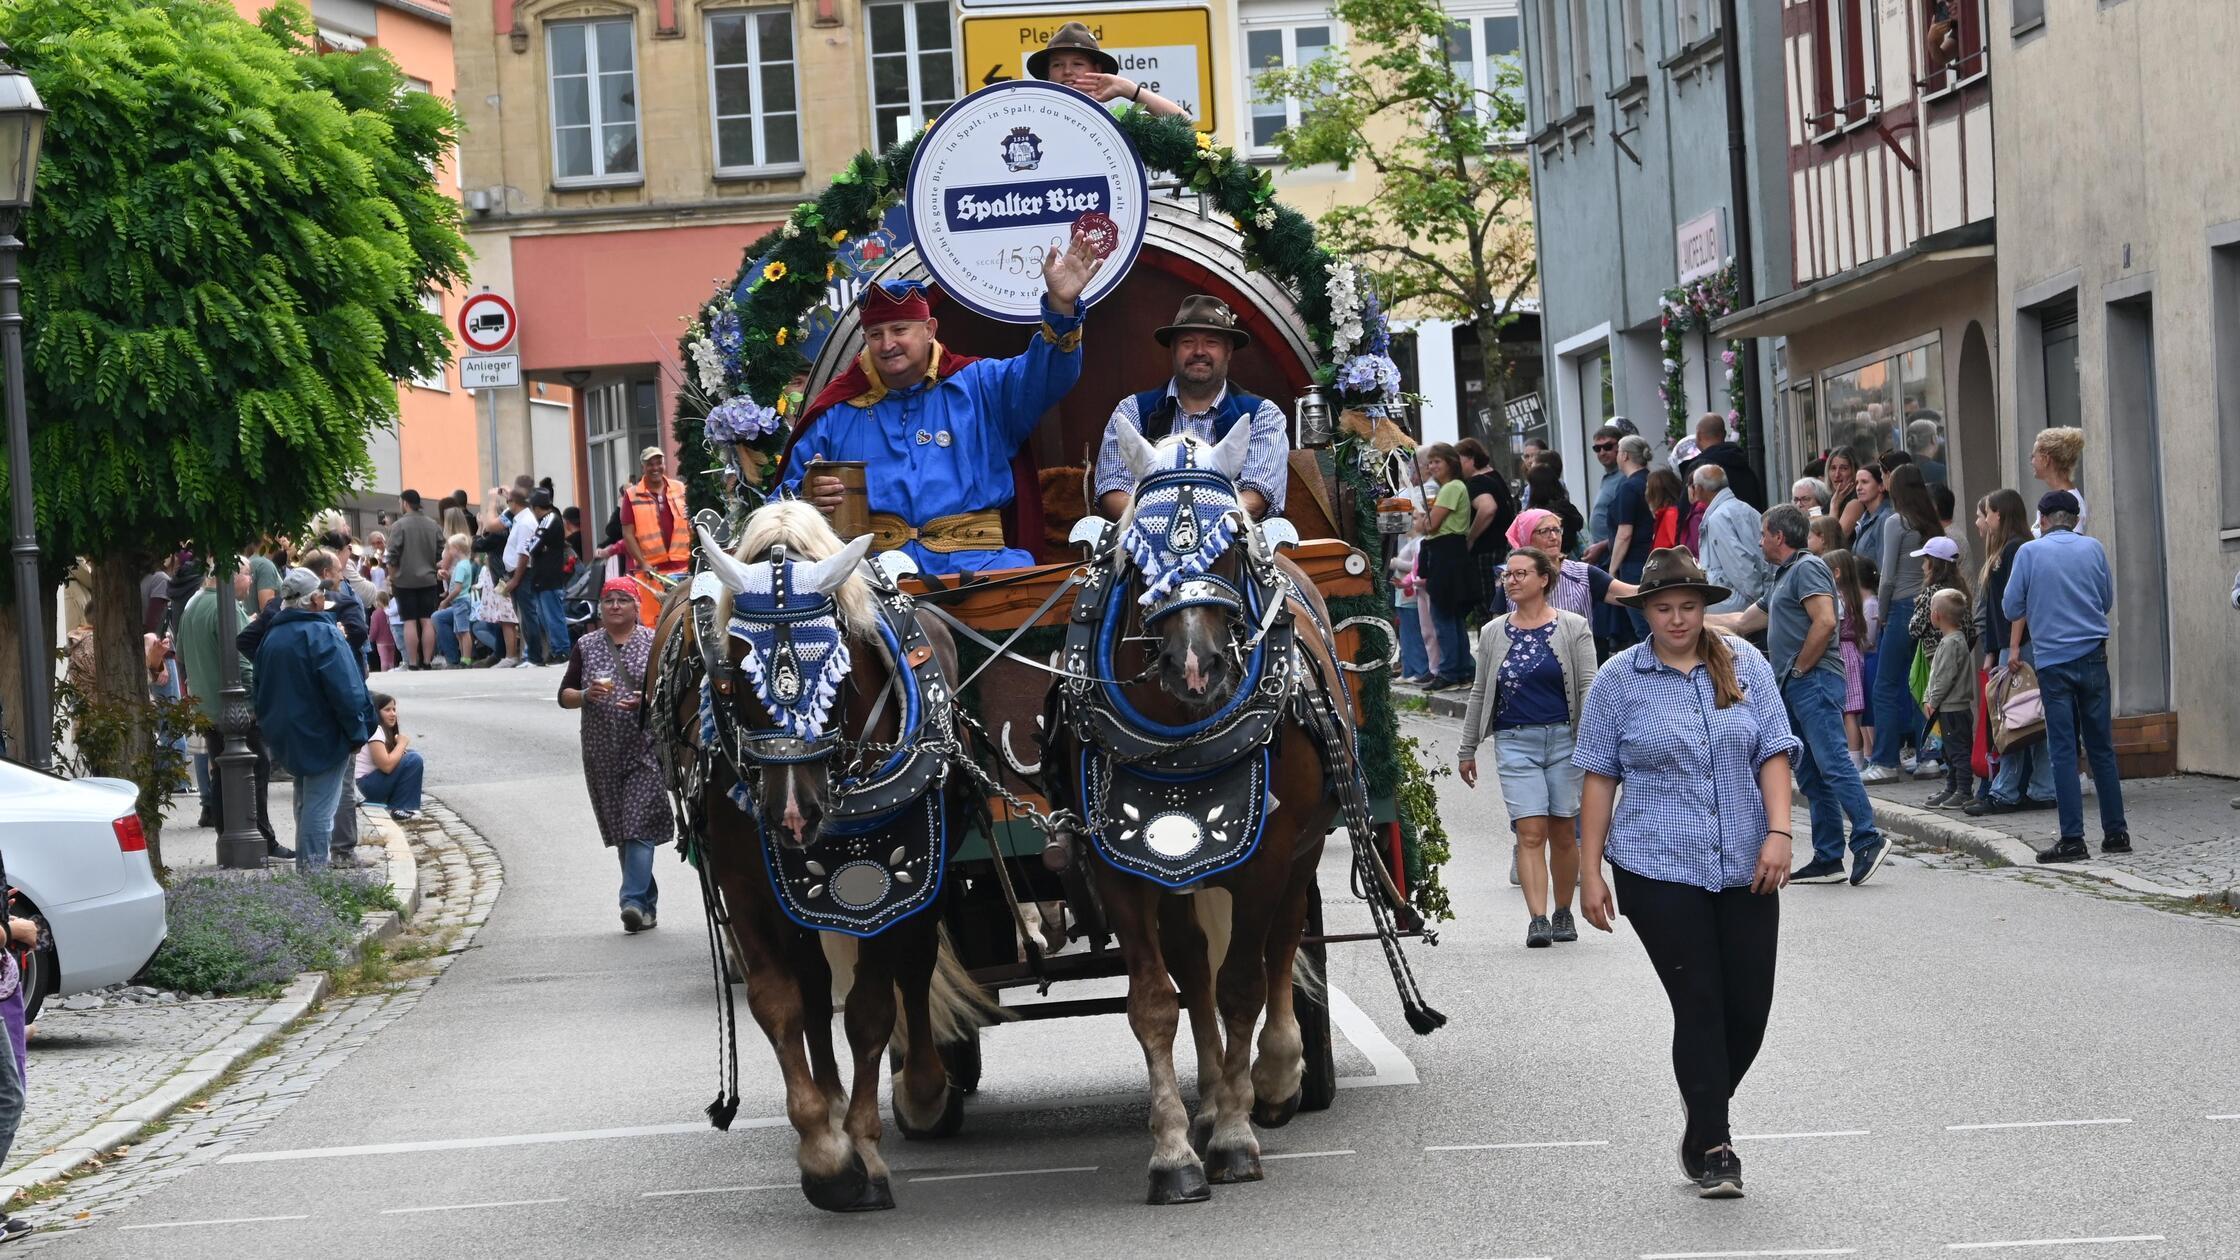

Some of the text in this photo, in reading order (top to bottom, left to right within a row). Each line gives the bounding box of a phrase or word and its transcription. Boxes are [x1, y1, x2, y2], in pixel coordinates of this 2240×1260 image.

[987, 111, 1000, 120] in
[1002, 104, 1036, 117] Spalt,
[1039, 105, 1060, 118] dou
[1064, 112, 1088, 133] wern
[1089, 132, 1104, 148] die
[1111, 173, 1123, 191] gor
[930, 187, 941, 217] goute
[956, 187, 1100, 222] Spalter Bier
[938, 235, 961, 267] macht
[466, 361, 512, 372] Anlieger
[481, 373, 499, 383] frei
